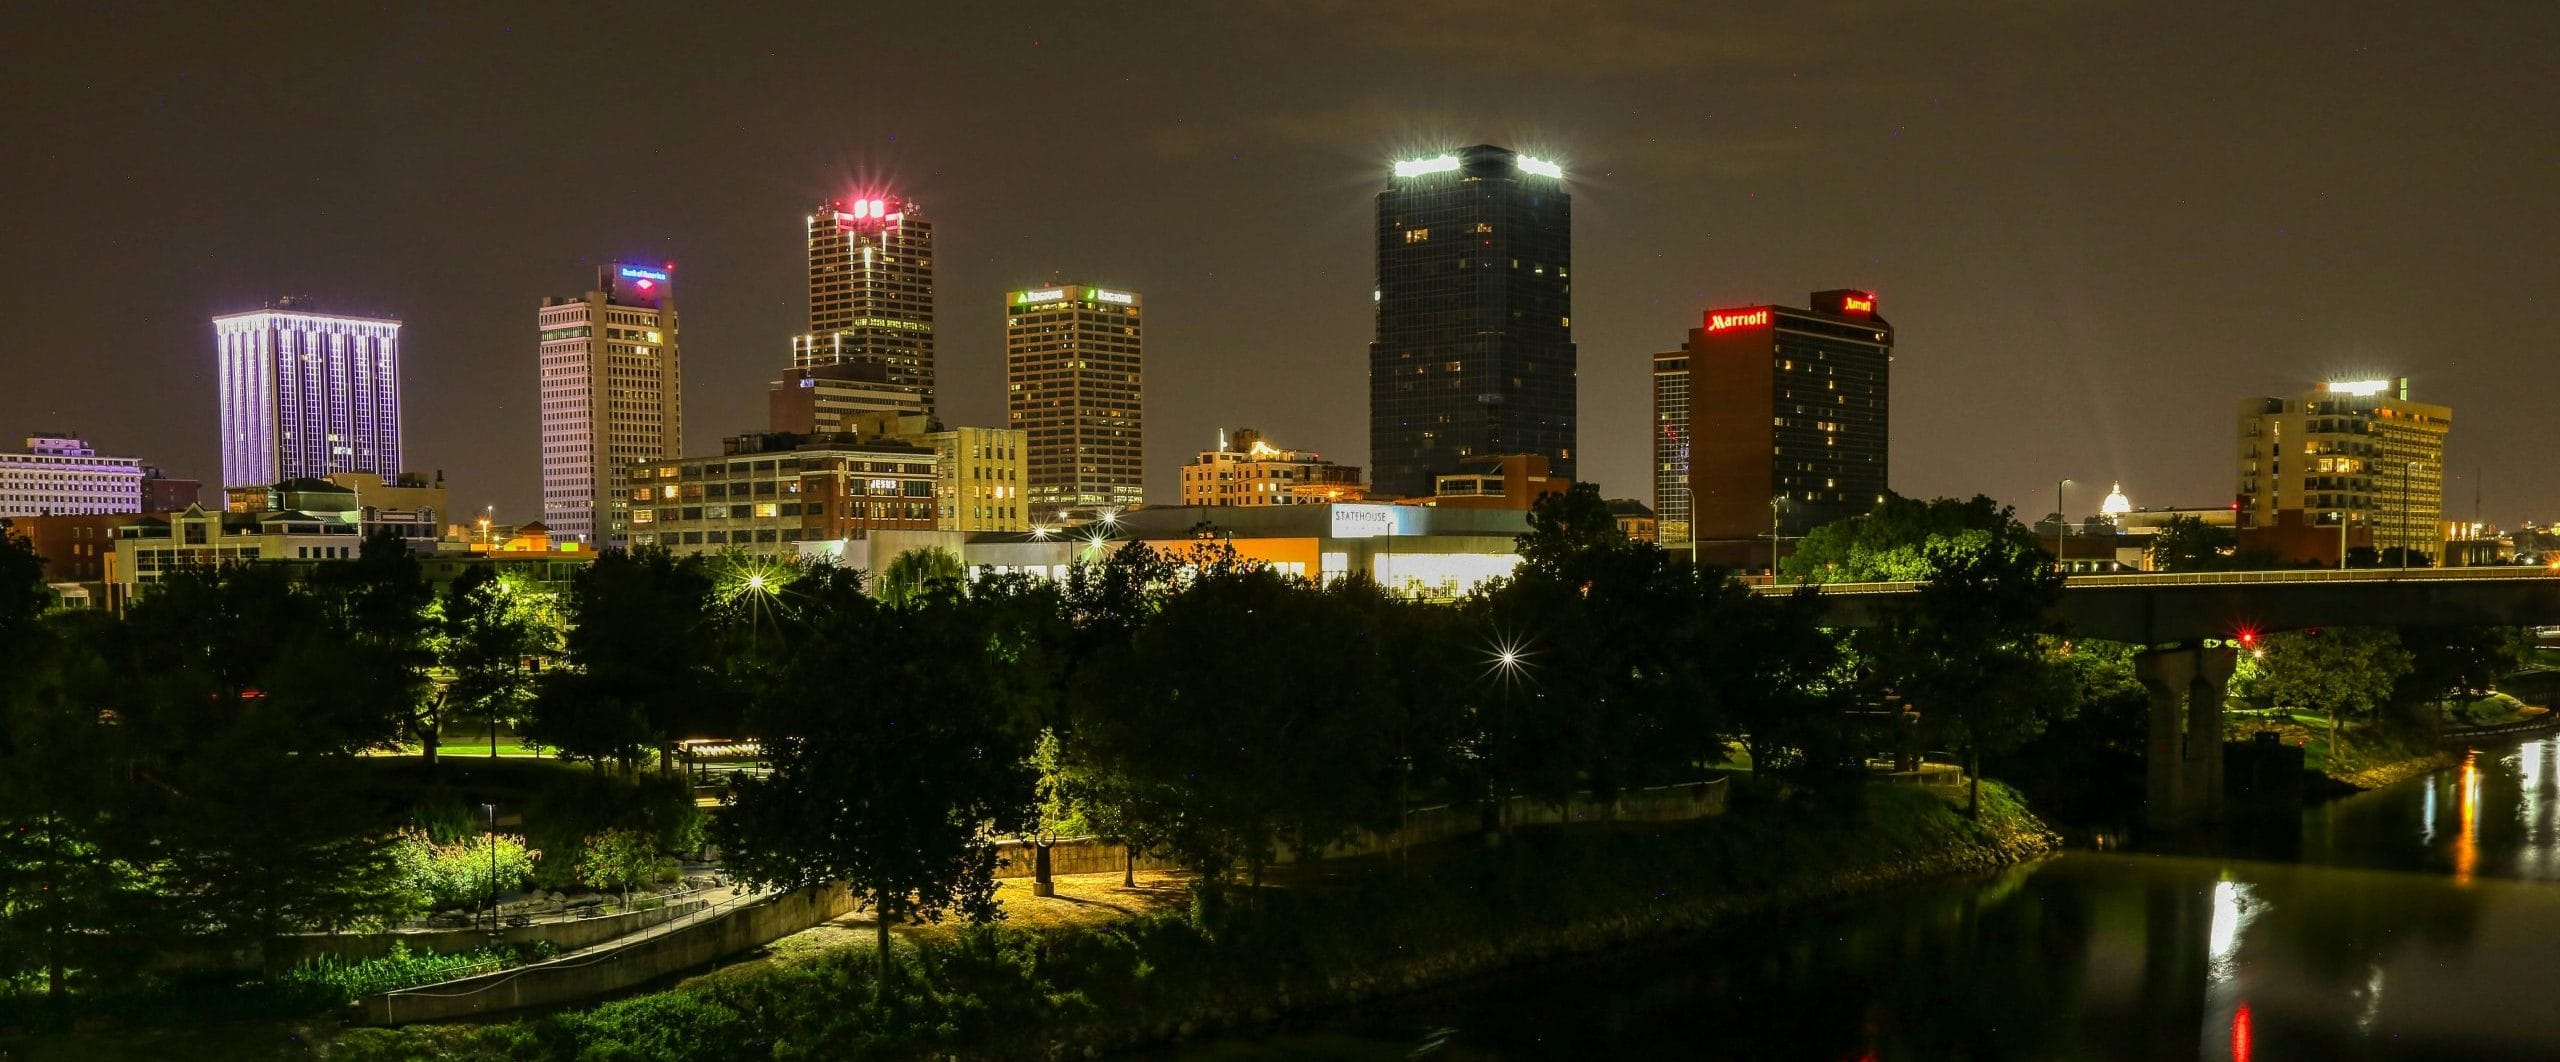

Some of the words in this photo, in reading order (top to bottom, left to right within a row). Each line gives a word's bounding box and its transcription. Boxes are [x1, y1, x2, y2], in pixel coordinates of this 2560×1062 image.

[1845, 297, 1870, 312] Marriott
[1708, 311, 1767, 331] Marriott
[870, 479, 897, 489] JESUS
[1335, 511, 1386, 521] STATEHOUSE
